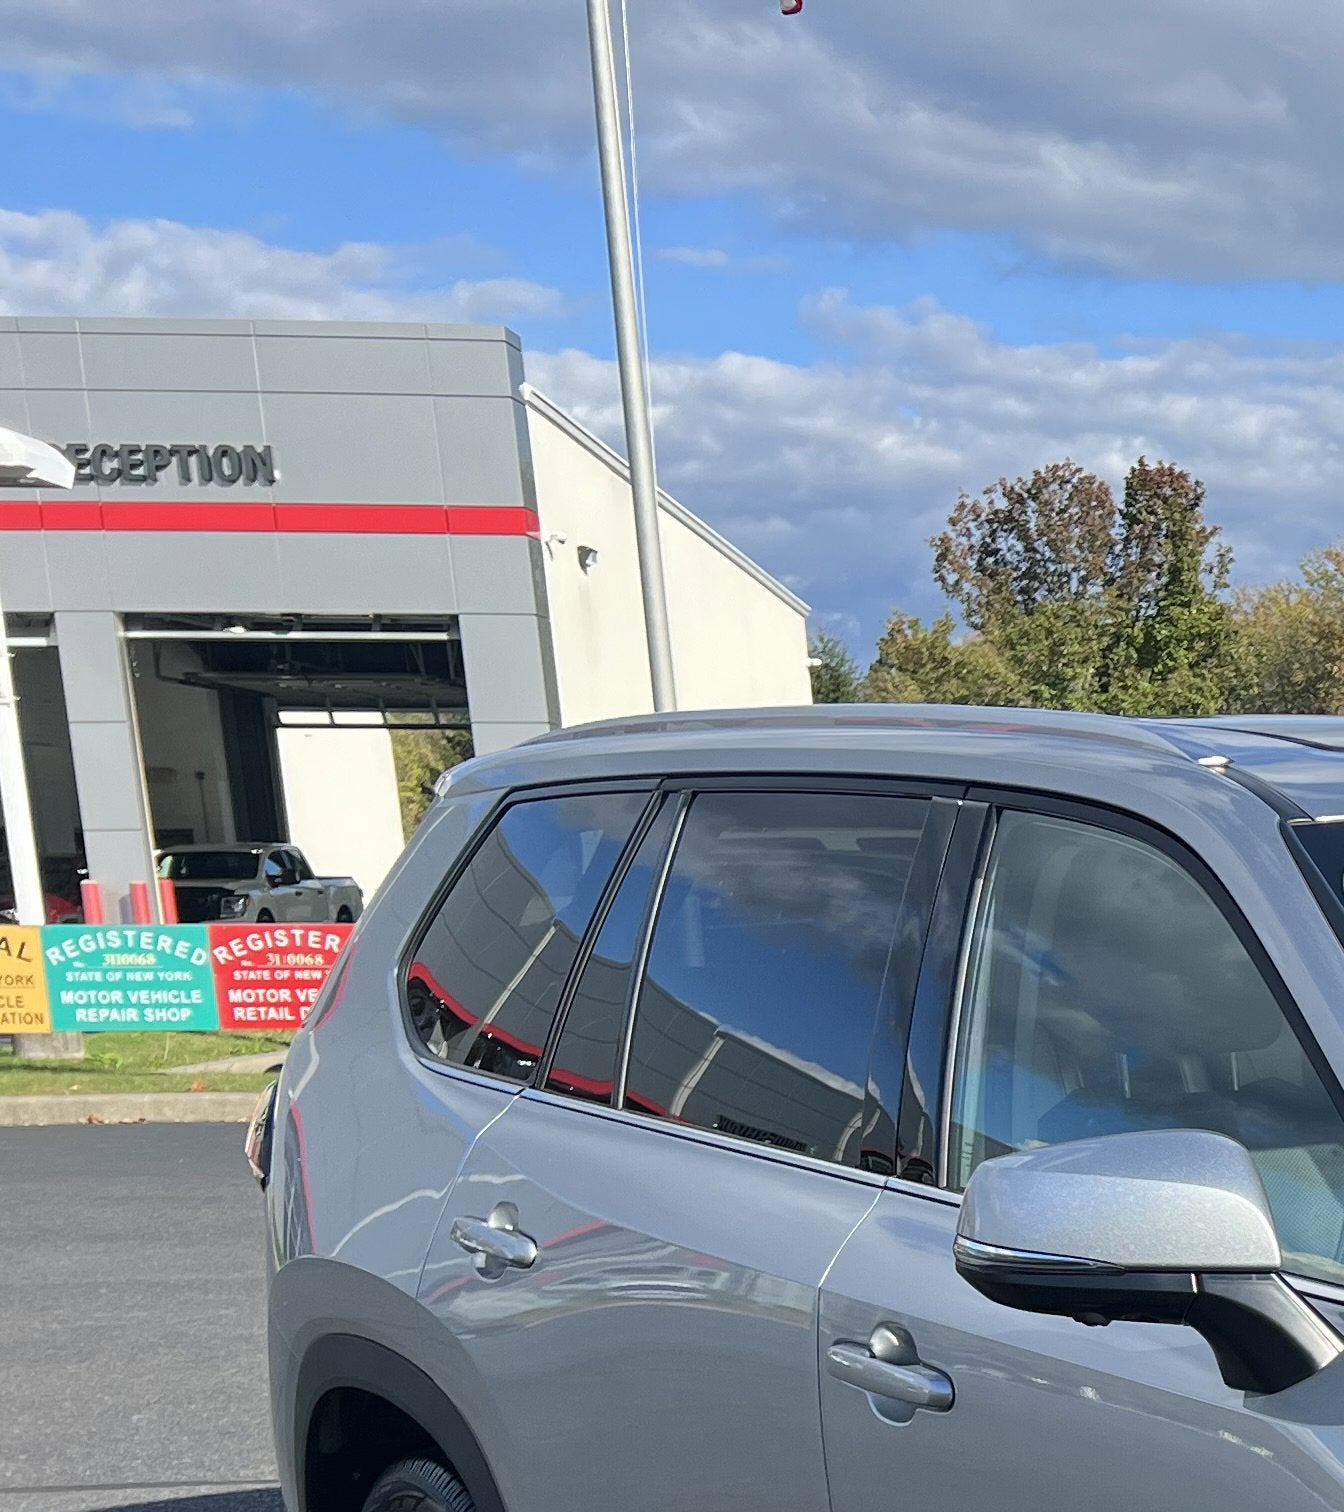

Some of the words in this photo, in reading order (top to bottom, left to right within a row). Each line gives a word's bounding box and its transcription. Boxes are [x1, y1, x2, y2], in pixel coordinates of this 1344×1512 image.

[45, 930, 208, 967] REGISTERED
[0, 974, 34, 986] ORK
[65, 971, 103, 982] STATE
[106, 971, 123, 982] OF
[126, 971, 154, 982] NEW
[157, 970, 193, 981] YORK
[233, 970, 271, 981] STATE
[274, 970, 291, 981] OF
[294, 970, 322, 981] NEW
[60, 990, 123, 1005] MOTOR
[126, 989, 204, 1004] VEHICLE
[228, 989, 292, 1004] MOTOR
[75, 1008, 139, 1023] REPAIR
[143, 1007, 193, 1022] SHOP
[233, 1006, 296, 1021] RETAIL
